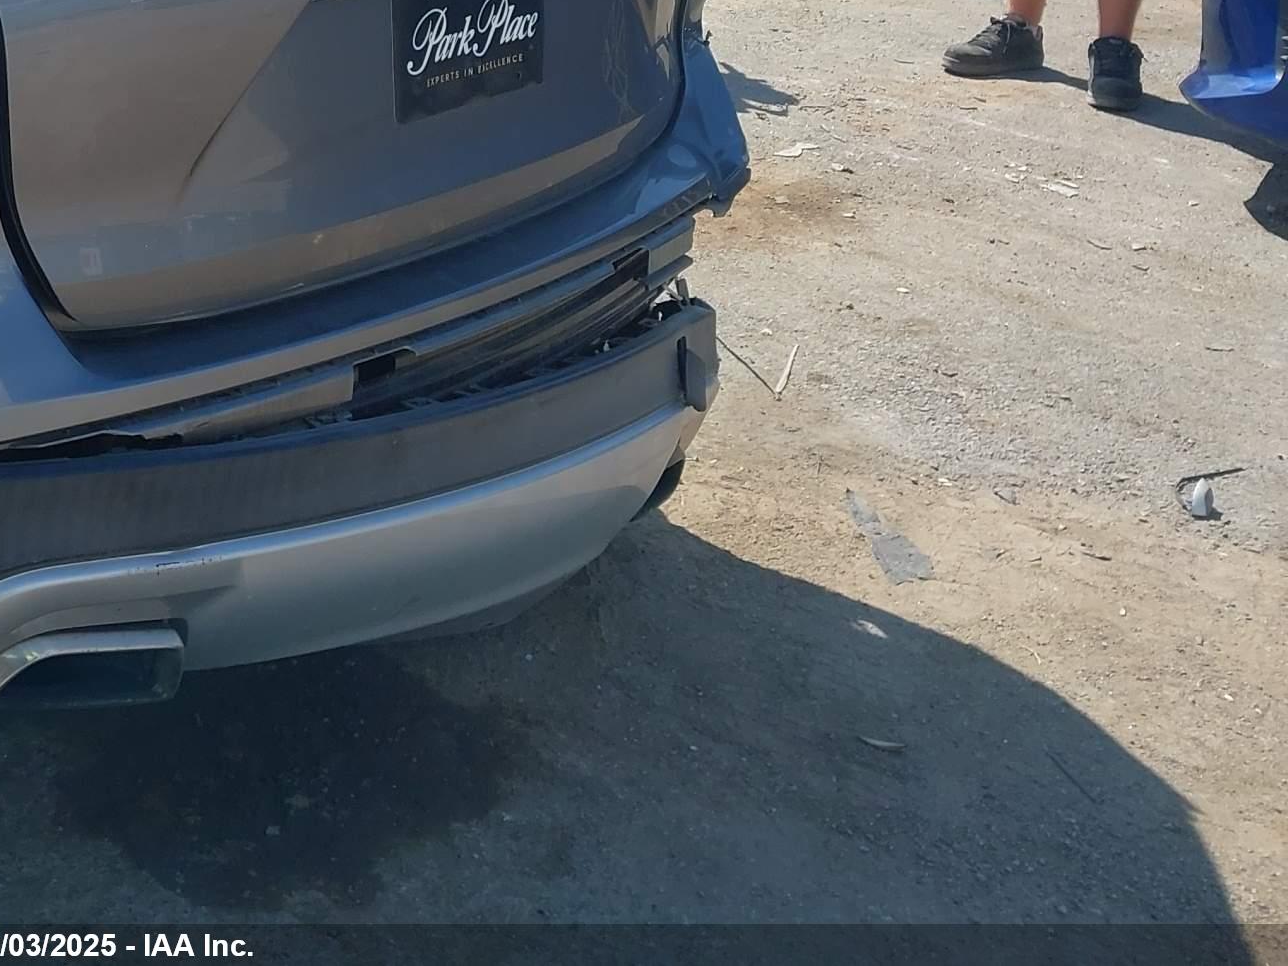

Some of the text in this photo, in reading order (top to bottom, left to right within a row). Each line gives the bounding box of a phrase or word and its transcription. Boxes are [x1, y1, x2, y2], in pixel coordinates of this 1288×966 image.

[407, 7, 475, 76] Park
[426, 53, 524, 88] EXPERTS IN EXCELLENCE
